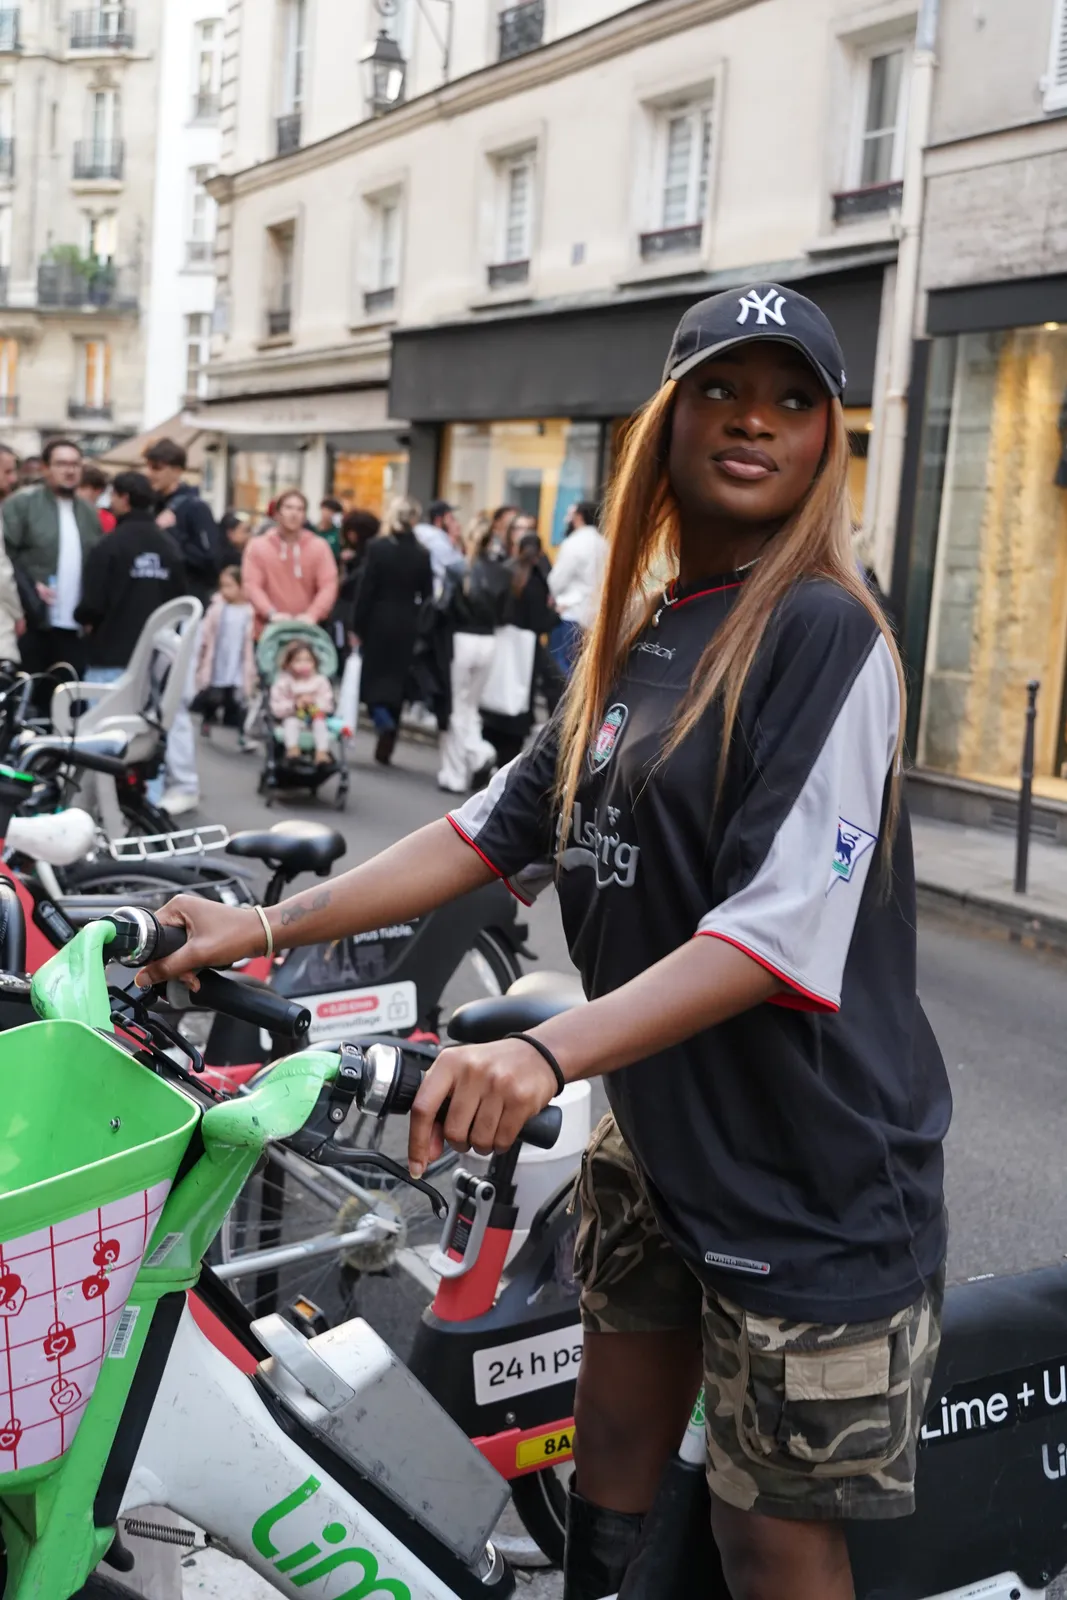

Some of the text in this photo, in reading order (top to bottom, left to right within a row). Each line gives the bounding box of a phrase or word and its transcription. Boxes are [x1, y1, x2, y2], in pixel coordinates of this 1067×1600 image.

[736, 289, 787, 326] NY
[488, 1356, 524, 1387] 24
[530, 1351, 546, 1376] h
[544, 1434, 571, 1456] 8A
[252, 1474, 411, 1600] Lim
